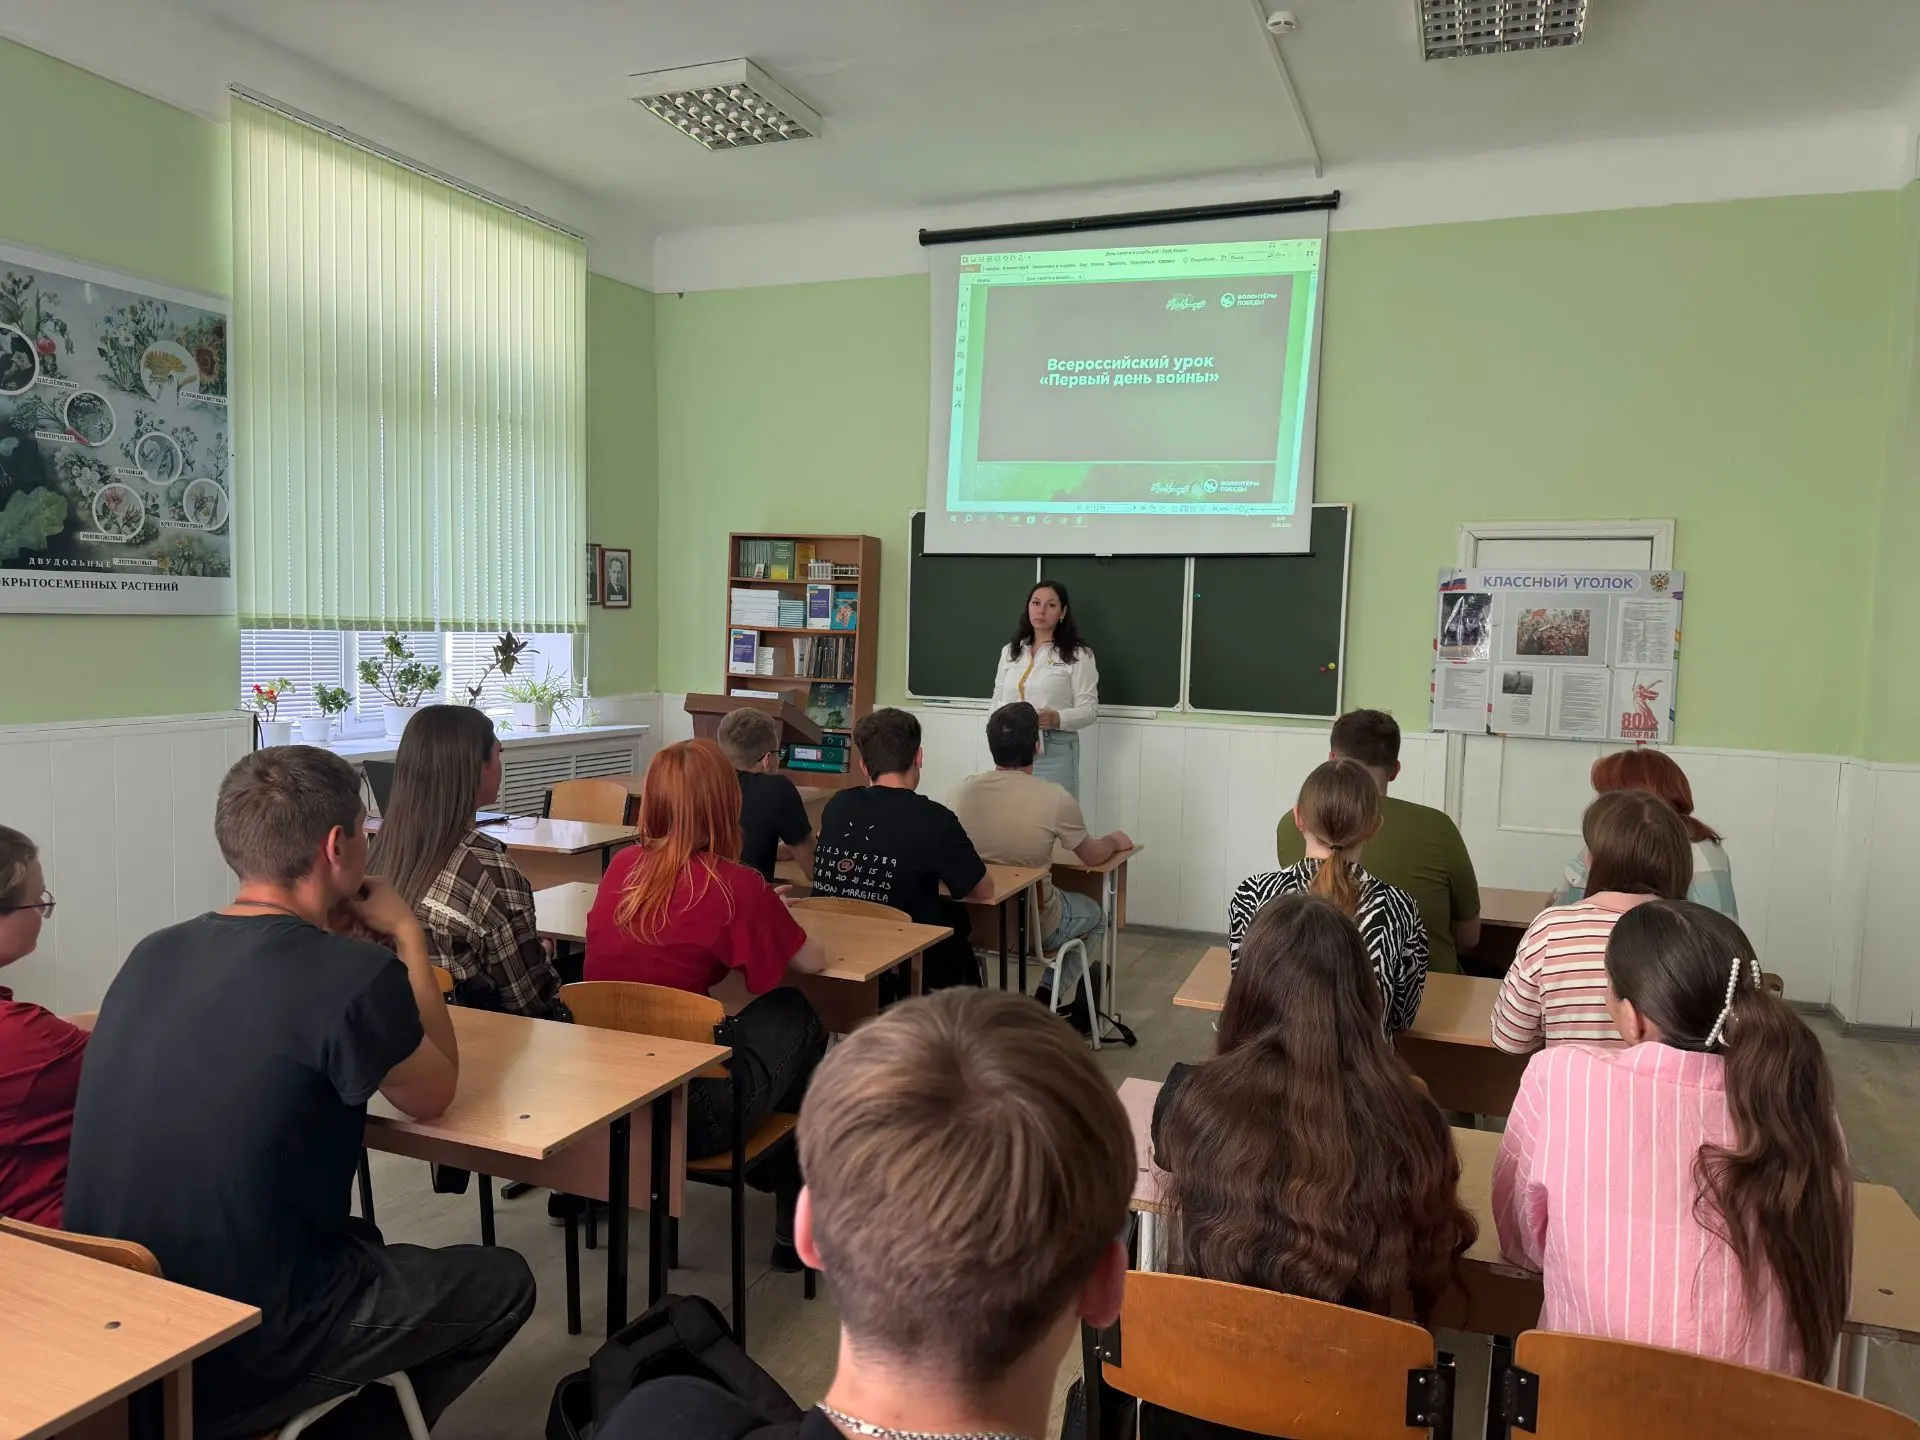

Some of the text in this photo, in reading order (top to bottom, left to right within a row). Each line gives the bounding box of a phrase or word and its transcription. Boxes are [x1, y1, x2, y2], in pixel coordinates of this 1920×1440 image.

[1047, 356, 1214, 373] Всероссийский урок
[1040, 370, 1220, 388] «Первый день войны»
[28, 557, 112, 569] ДВУДОЛЬНЫЕ
[0, 577, 179, 592] КРЫТОСЕМЕННЫХ РАСТЕНИЙ
[1483, 574, 1634, 590] КЛАССНЫЙ УГОЛОК
[1621, 712, 1642, 730] 80
[891, 859, 897, 867] 9
[885, 870, 893, 878] 16
[812, 881, 888, 902] AISON MARGIELA
[879, 882, 891, 890] 23
